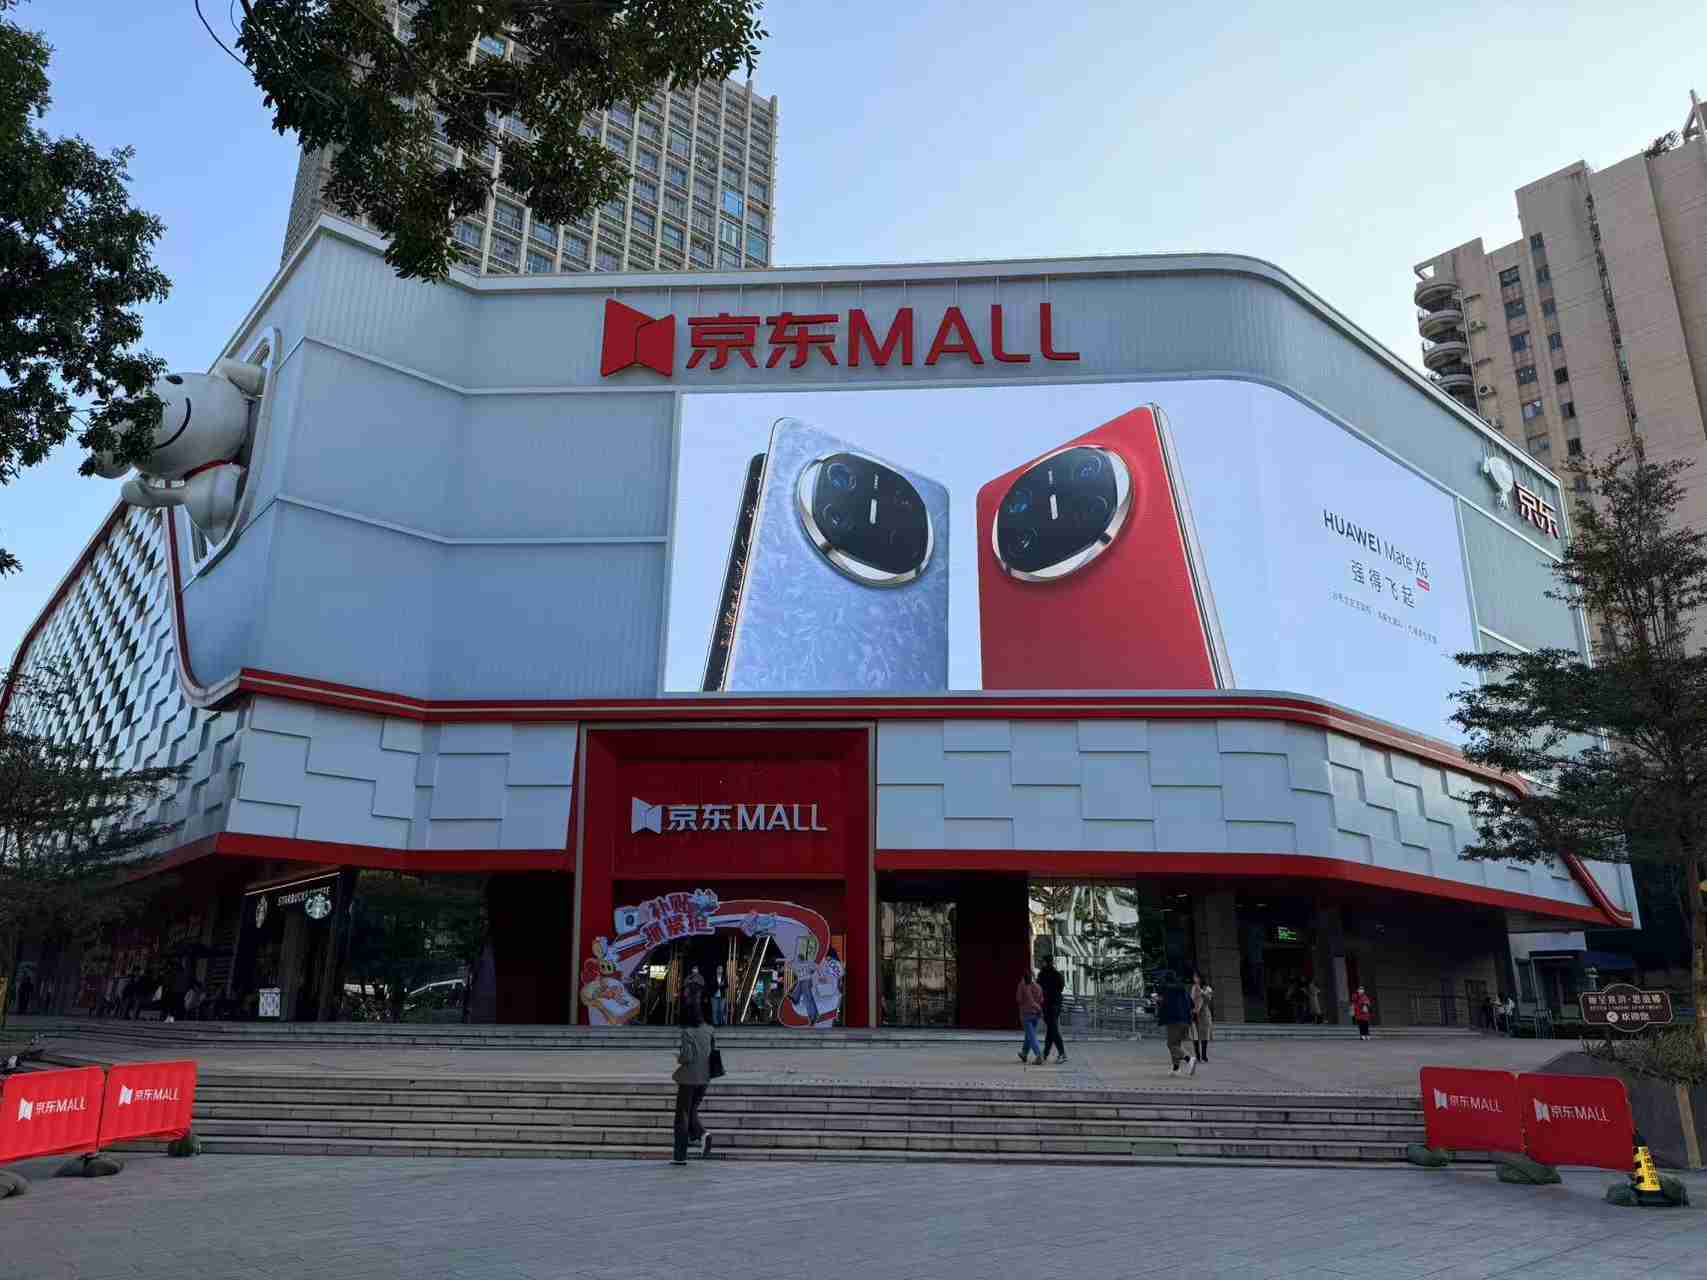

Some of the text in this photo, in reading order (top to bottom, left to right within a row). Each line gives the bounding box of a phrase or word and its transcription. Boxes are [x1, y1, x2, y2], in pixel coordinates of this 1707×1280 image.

[685, 302, 1080, 370] 京东MALL
[1514, 482, 1560, 539] 京东
[1323, 508, 1382, 555] HUAWEI
[1383, 541, 1413, 571] Mate
[667, 803, 828, 831] 京东MALL
[35, 1097, 87, 1114] 京东MALL
[134, 1087, 180, 1101] 京东MALL
[1448, 1095, 1503, 1113] 京东MALL
[1551, 1105, 1610, 1122] 京东MALL
